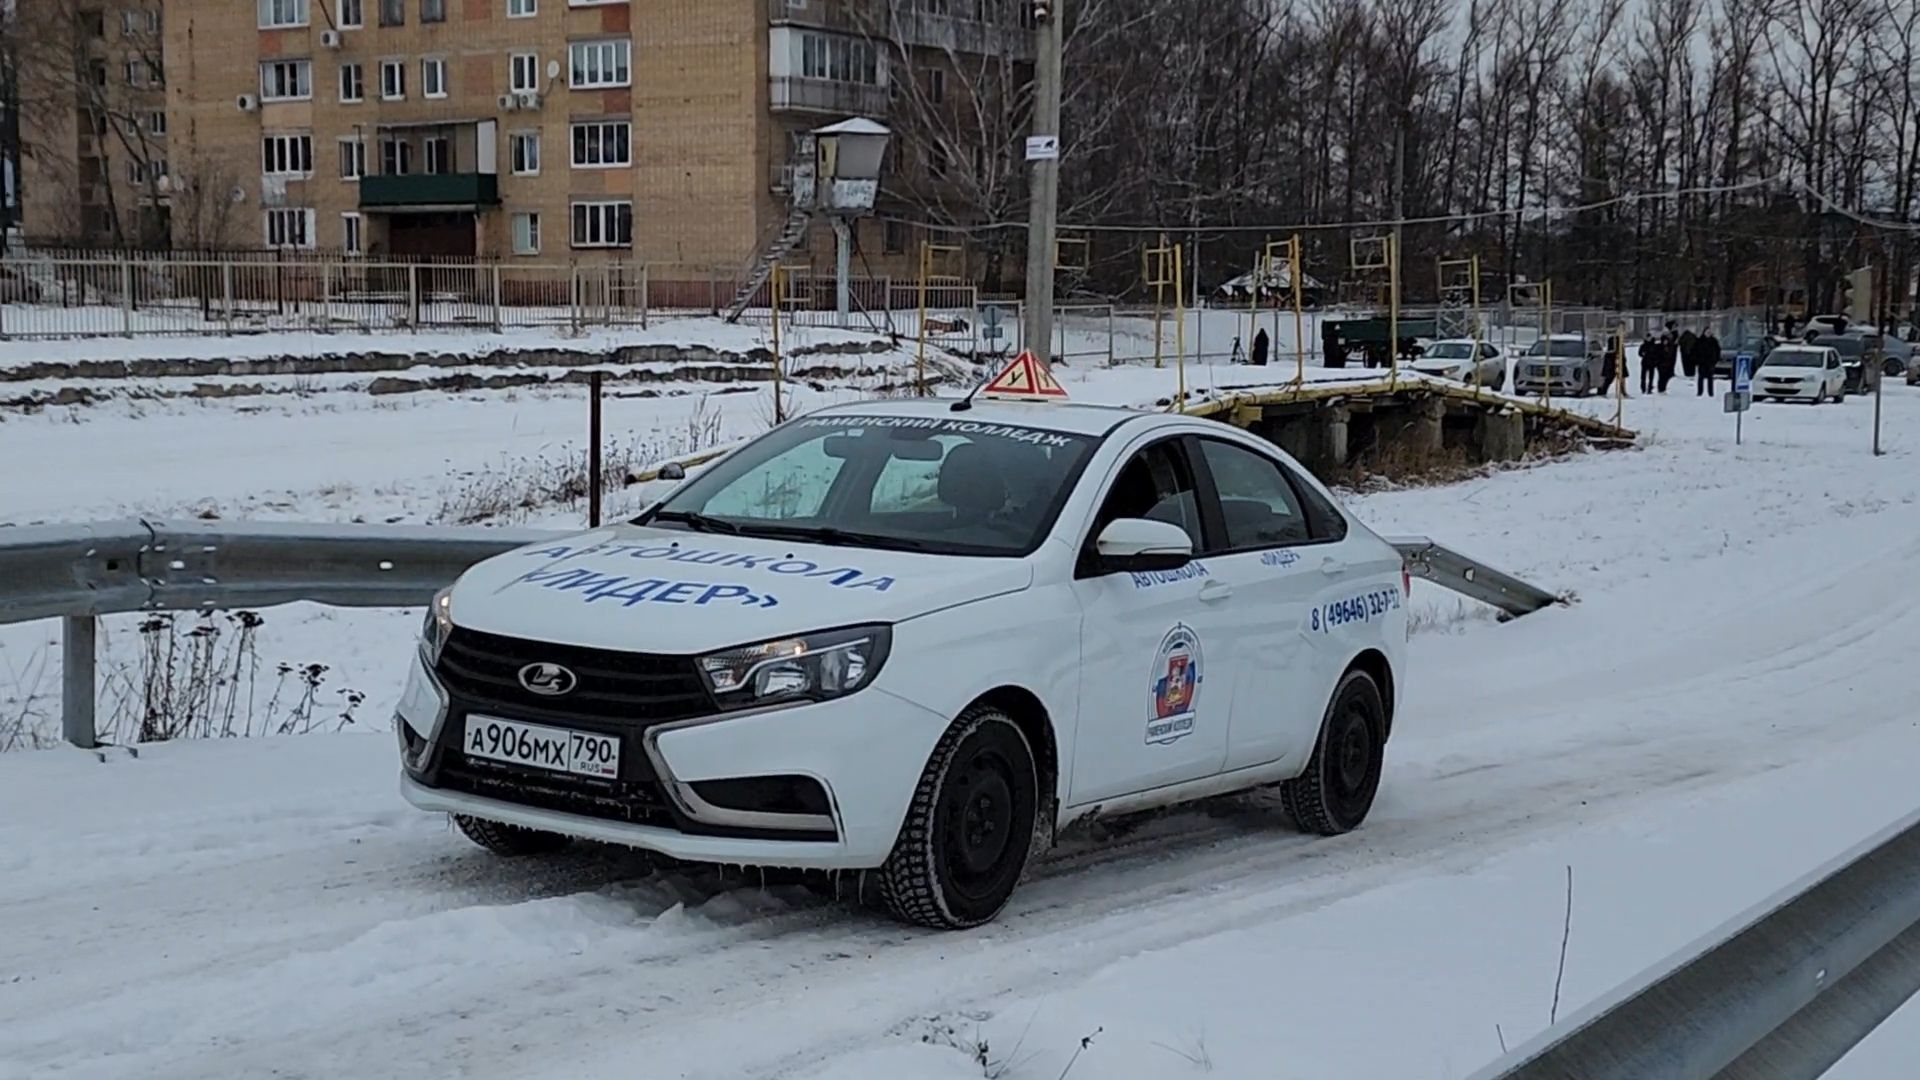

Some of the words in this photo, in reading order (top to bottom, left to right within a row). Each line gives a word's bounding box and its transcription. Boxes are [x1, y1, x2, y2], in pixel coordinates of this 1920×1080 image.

[1007, 371, 1024, 386] У
[942, 421, 1072, 447] КОЛЛЕДЖ
[1311, 607, 1320, 631] 8
[1322, 595, 1369, 634] (49646)
[471, 723, 567, 766] А906МХ
[572, 735, 612, 763] 790
[580, 761, 600, 773] RUS
